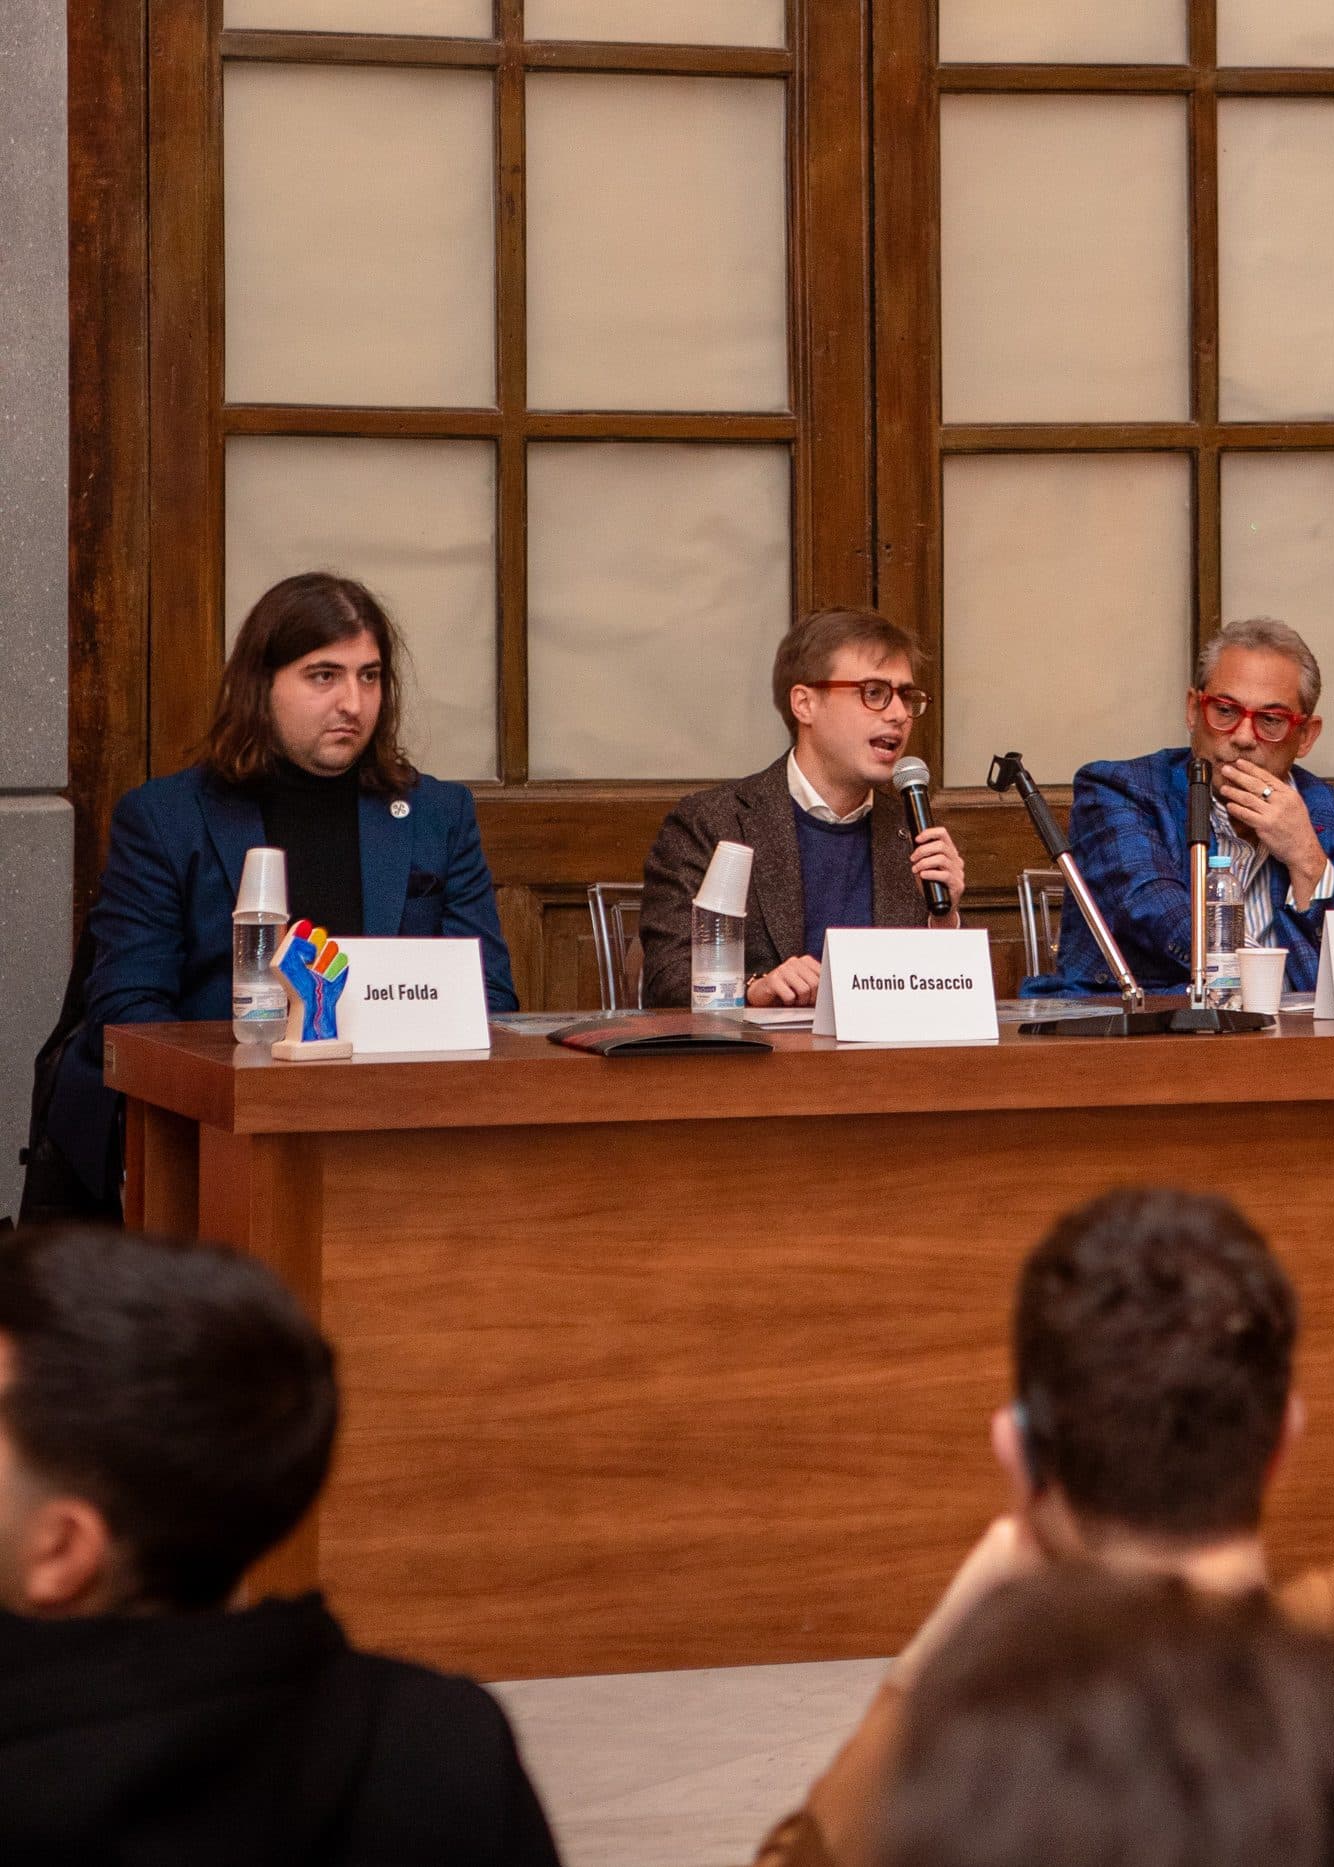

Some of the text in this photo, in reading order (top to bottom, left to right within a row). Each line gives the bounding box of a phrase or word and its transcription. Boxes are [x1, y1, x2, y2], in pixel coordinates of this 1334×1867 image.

[851, 974, 973, 990] Antonio Casaccio
[364, 984, 438, 1000] Joel Folda
